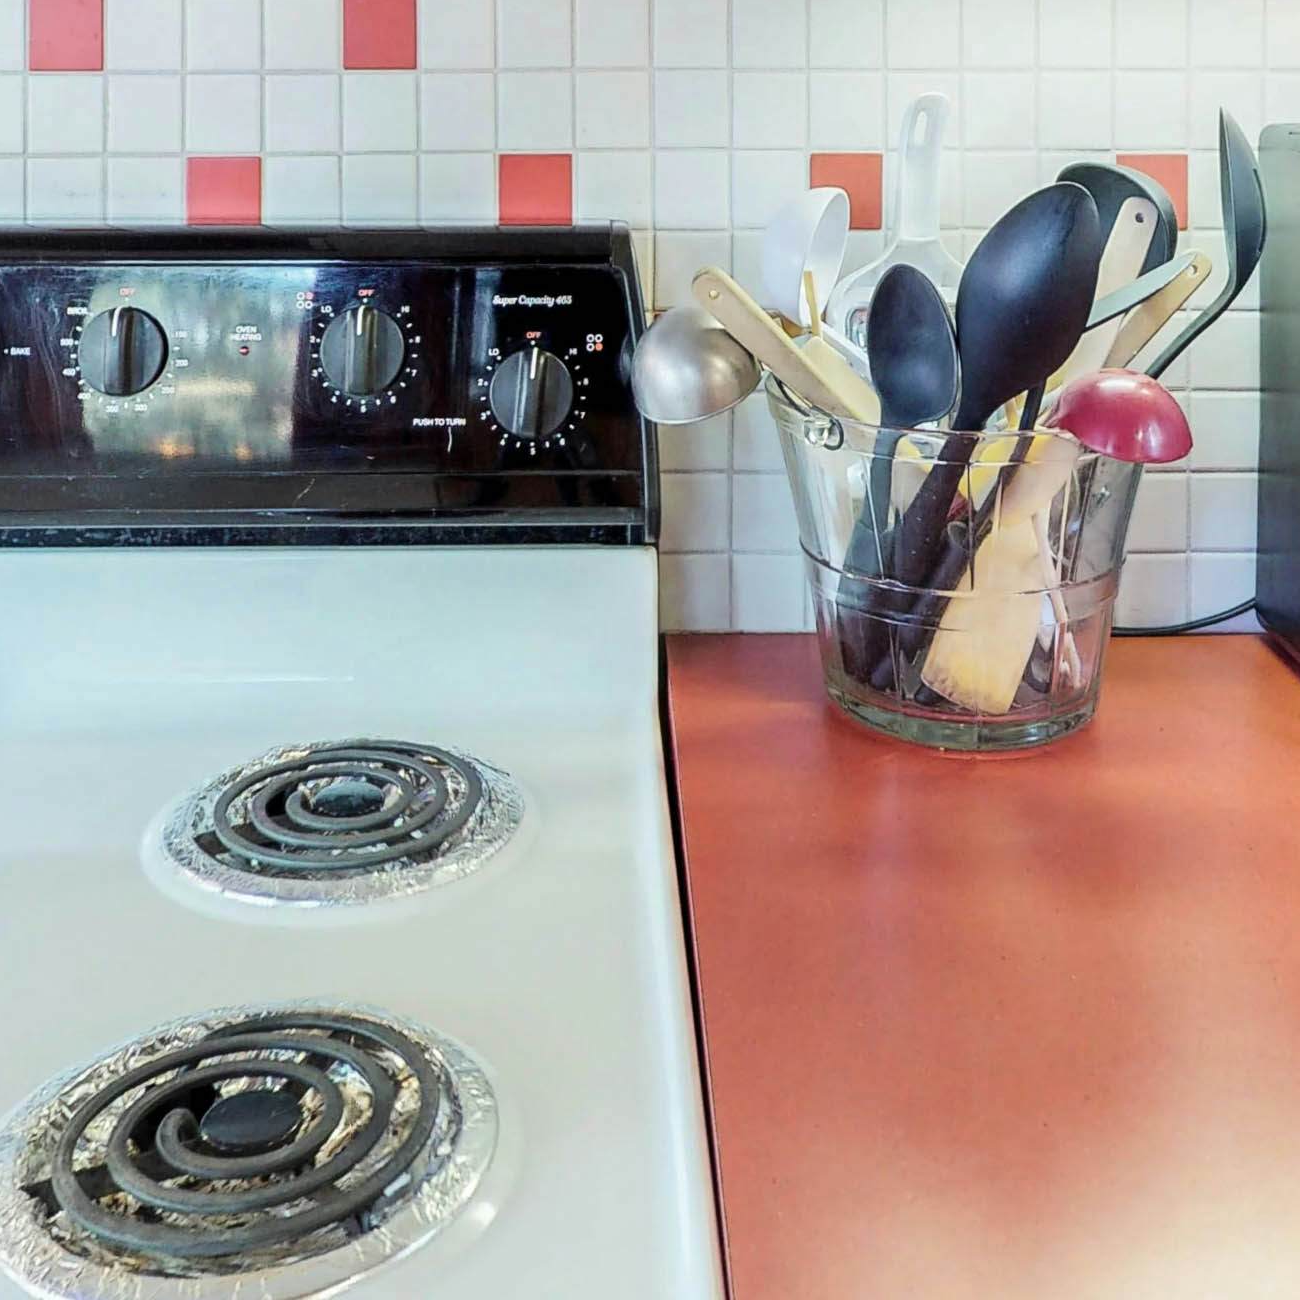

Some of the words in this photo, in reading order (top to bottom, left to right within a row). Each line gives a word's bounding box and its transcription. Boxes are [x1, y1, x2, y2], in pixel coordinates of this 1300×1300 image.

[119, 288, 135, 296] OFF
[358, 289, 375, 297] OFF
[493, 295, 518, 307] Super
[518, 295, 555, 307] Capacity
[320, 305, 332, 313] LO
[400, 305, 411, 313] HI
[236, 325, 257, 333] OVEN
[229, 333, 262, 341] HEATING
[526, 331, 542, 339] OFF
[10, 347, 31, 356] BAKE
[488, 348, 500, 356] LO
[569, 348, 578, 356] HI
[477, 378, 484, 386] 2
[480, 412, 487, 421] 3
[580, 411, 586, 419] 7
[412, 417, 434, 426] PUSH
[435, 417, 445, 426] TO
[446, 417, 467, 427] TURN
